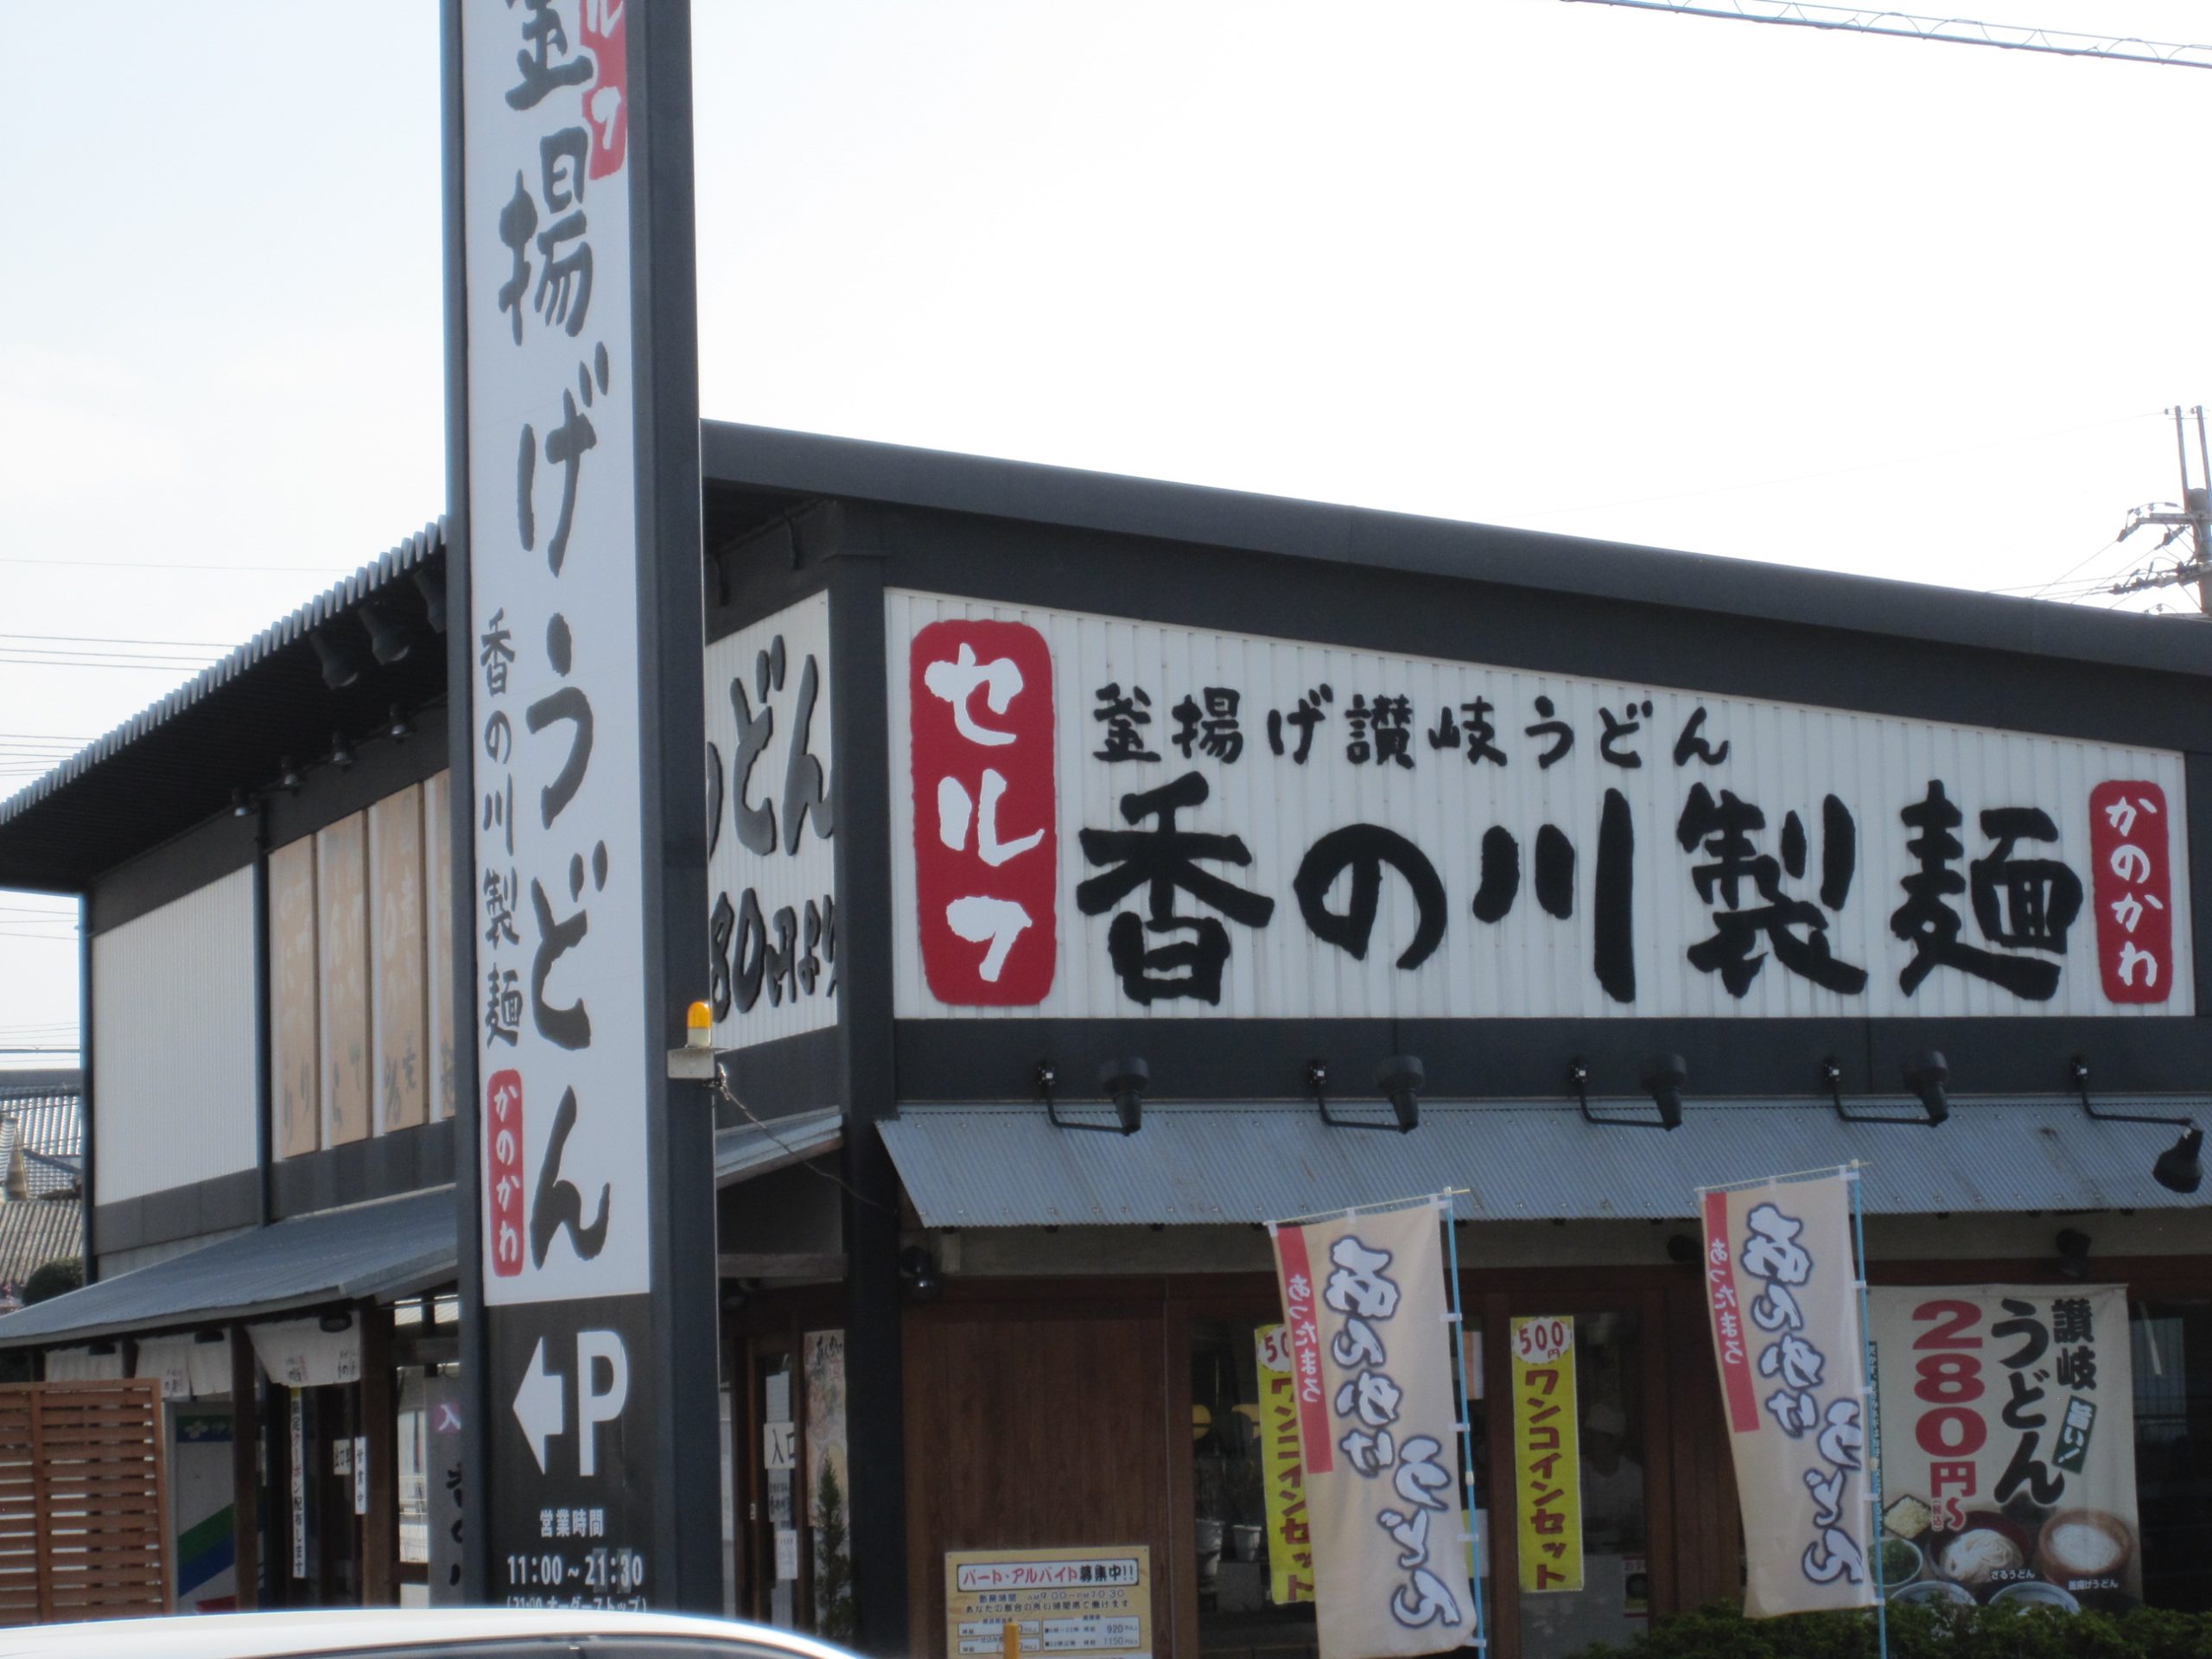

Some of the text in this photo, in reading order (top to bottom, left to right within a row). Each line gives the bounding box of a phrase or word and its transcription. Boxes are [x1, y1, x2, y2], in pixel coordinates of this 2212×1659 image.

[480, 607, 524, 1048] 香の川製麺
[925, 643, 1044, 982] セルフ
[1077, 771, 2083, 1007] 香の川製麺
[2106, 795, 2164, 988] かのかわ
[494, 1083, 519, 1264] かのかわ
[577, 1330, 628, 1477] P
[1991, 1298, 2064, 1504] うどん
[2051, 1298, 2097, 1390] 讃岐
[540, 1508, 605, 1538] 営業時間
[772, 1427, 796, 1465] 入口
[1525, 1370, 1567, 1590] ワンコインセット
[1991, 1569, 2035, 1580] ざるうどん
